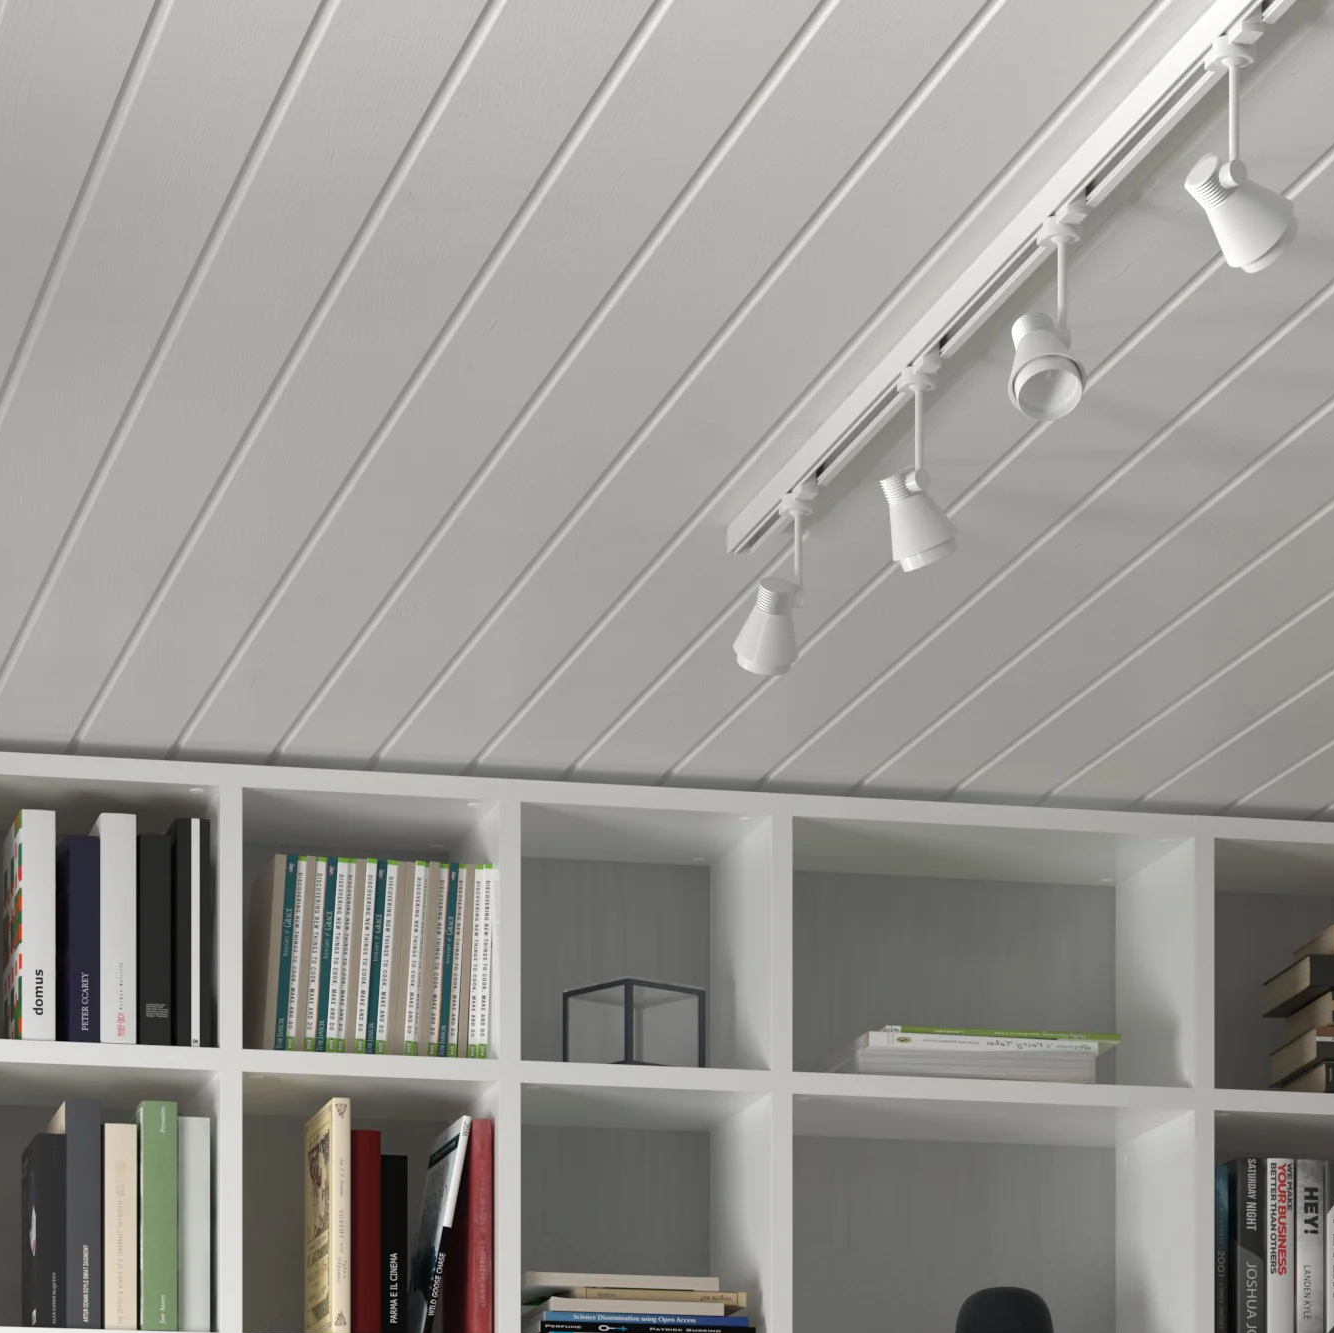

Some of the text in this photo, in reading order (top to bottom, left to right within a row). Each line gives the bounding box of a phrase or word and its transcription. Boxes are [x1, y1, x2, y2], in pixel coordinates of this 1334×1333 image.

[414, 876, 422, 916] DISCOVERING
[411, 960, 417, 968] TO
[32, 969, 44, 1016] domus
[407, 1025, 413, 1034] DO
